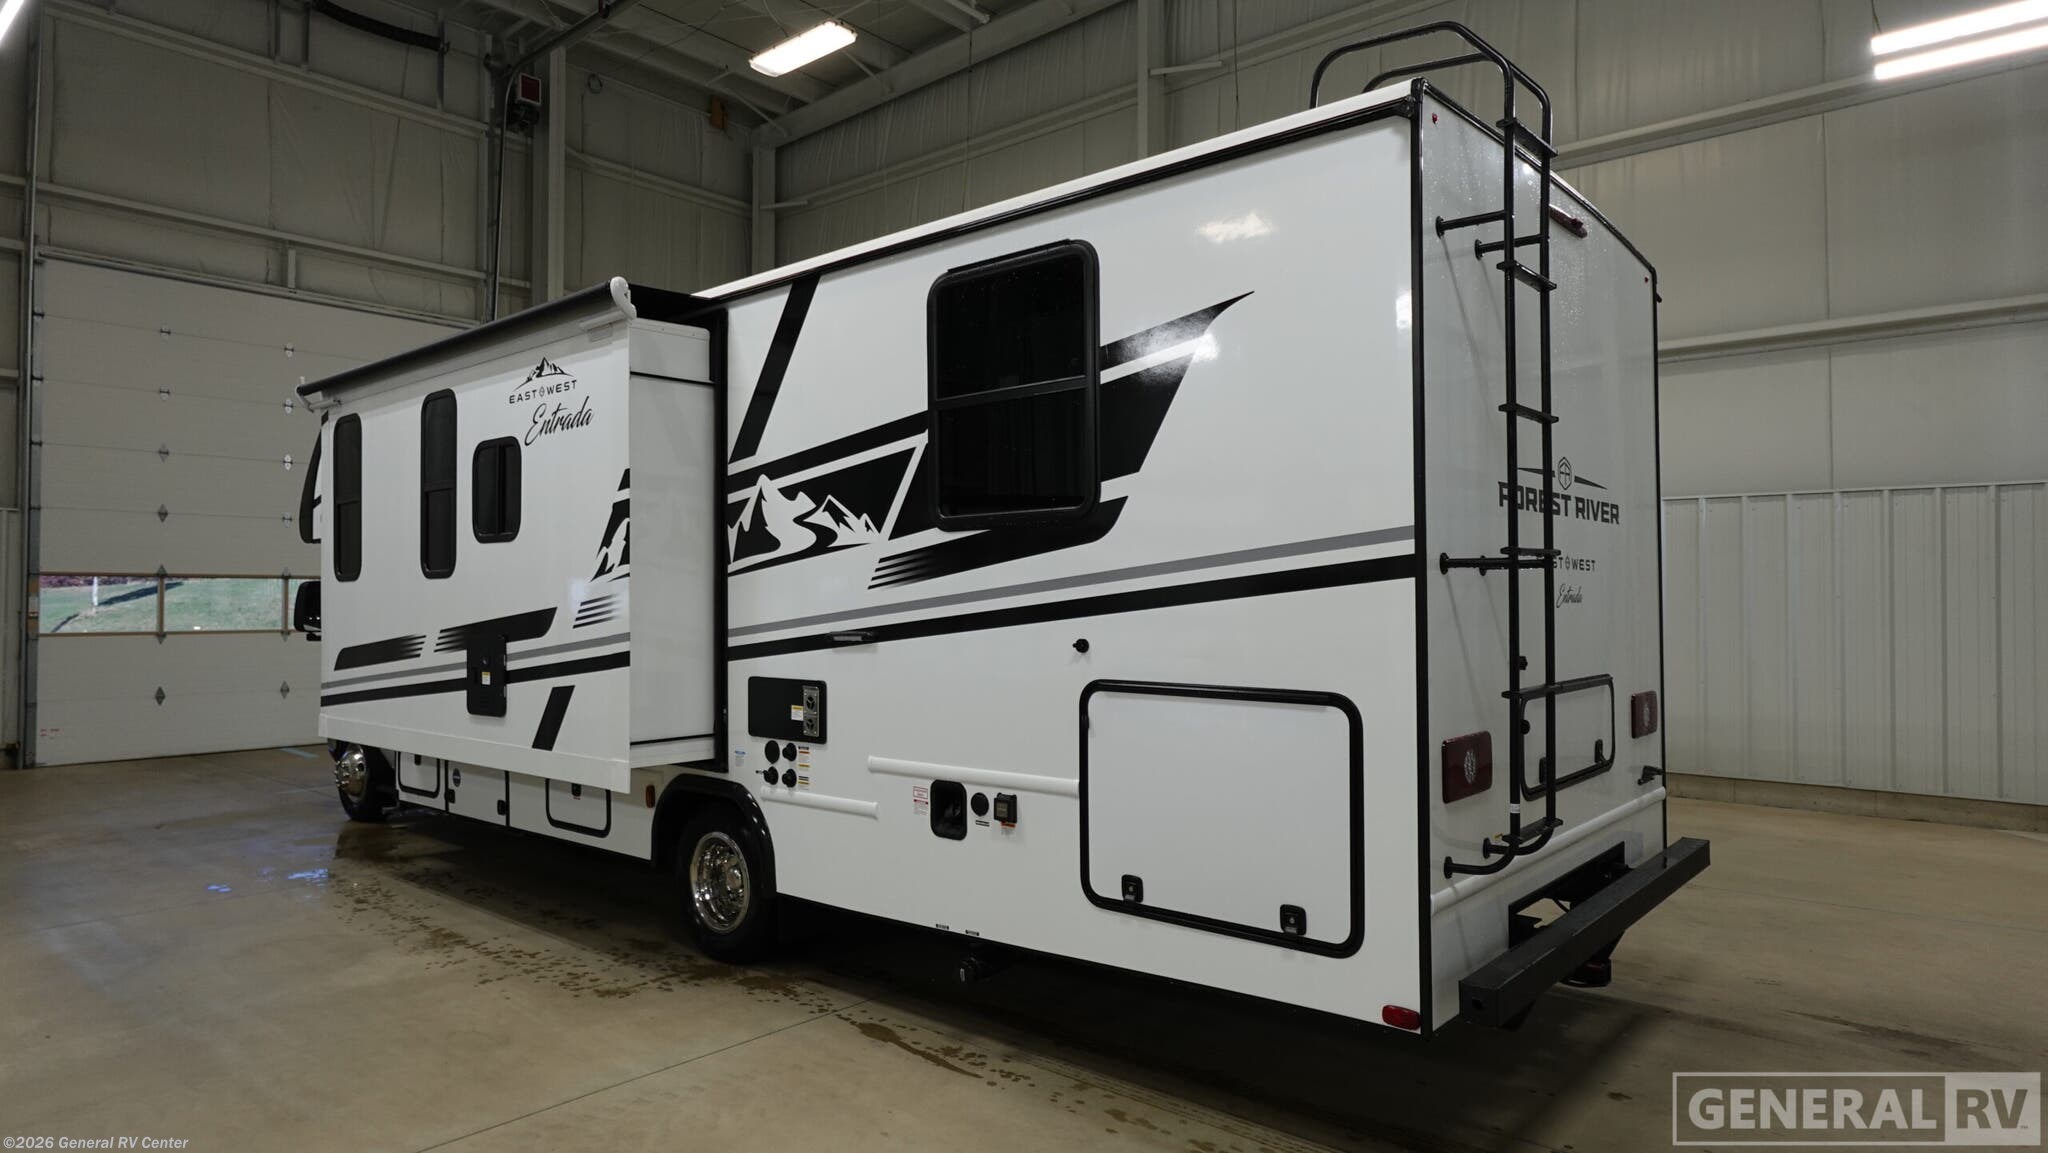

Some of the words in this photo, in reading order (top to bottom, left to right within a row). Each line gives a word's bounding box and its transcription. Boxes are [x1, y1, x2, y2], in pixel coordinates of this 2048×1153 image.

[508, 389, 537, 405] EAST
[546, 379, 577, 397] WEST
[523, 402, 593, 447] Entrada
[1498, 481, 1571, 517] FOREST
[1575, 496, 1620, 525] RIVER
[1571, 557, 1596, 572] WEST
